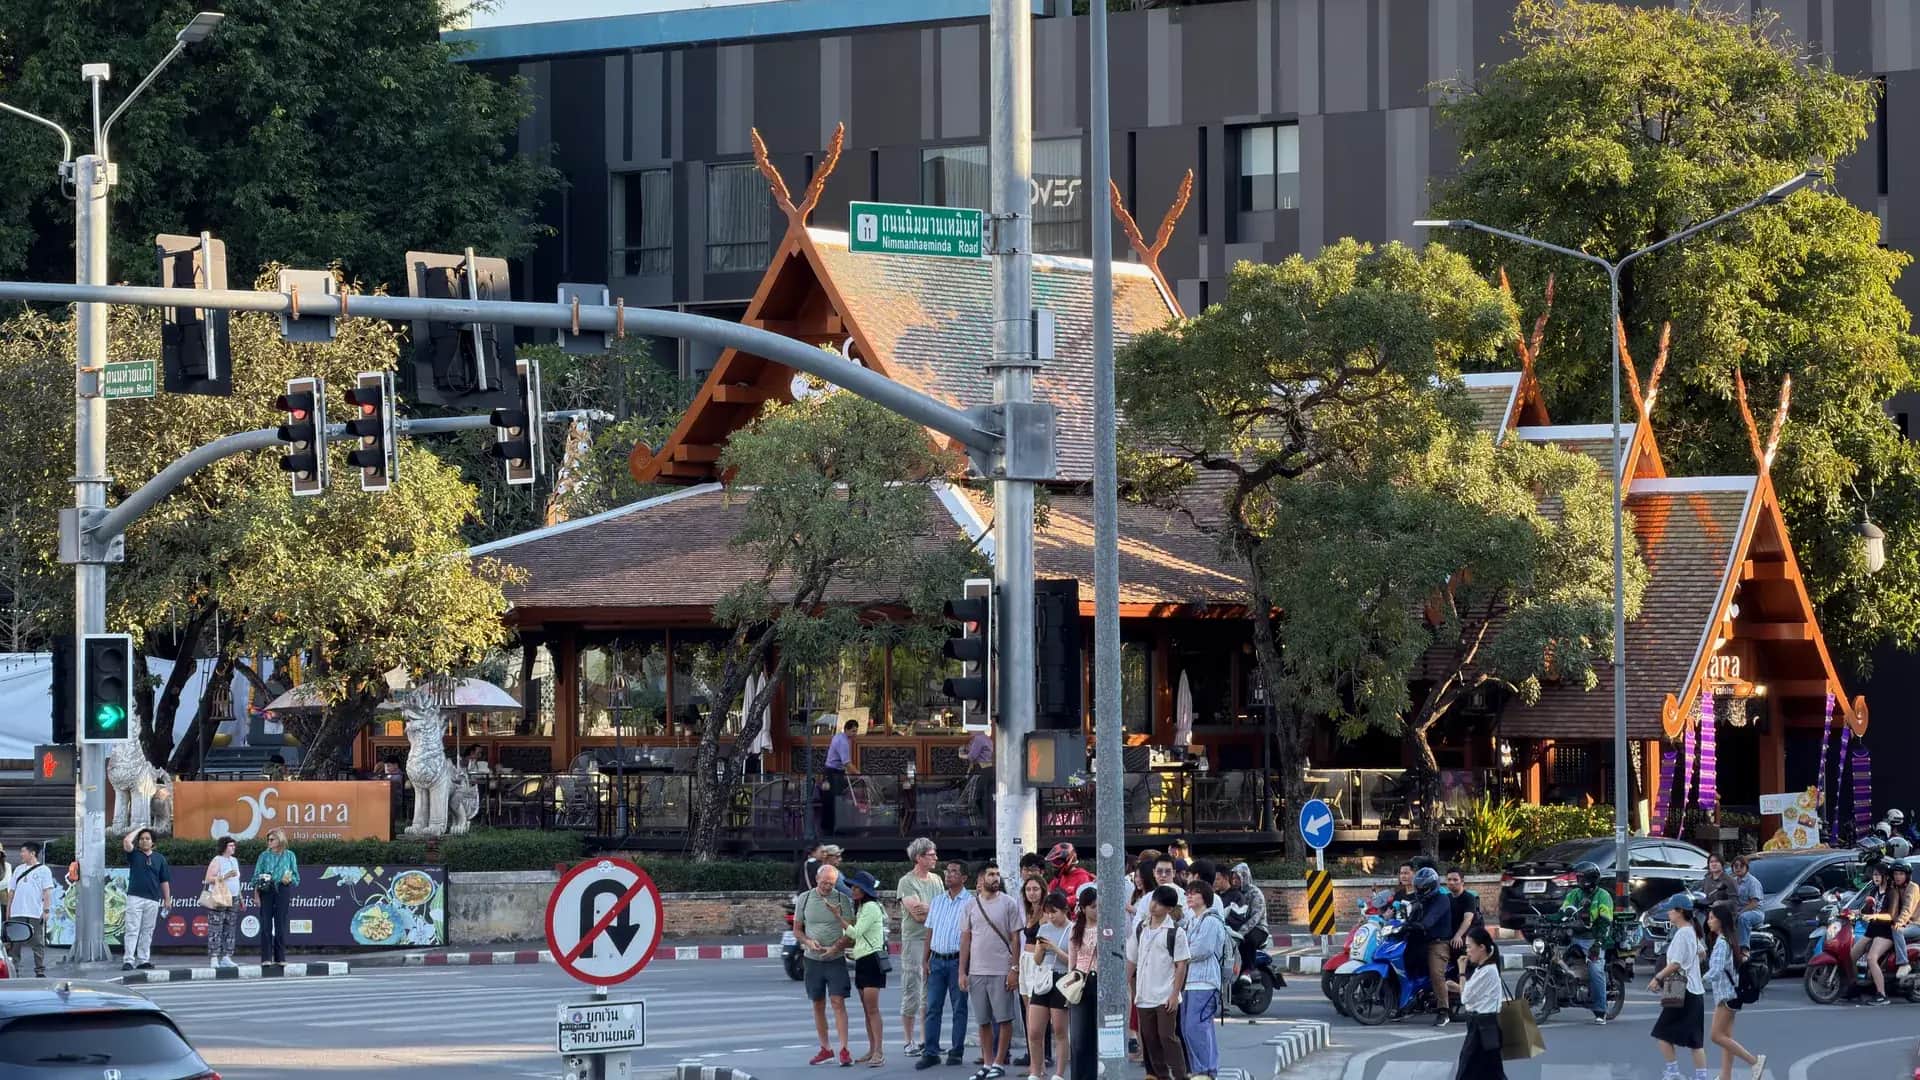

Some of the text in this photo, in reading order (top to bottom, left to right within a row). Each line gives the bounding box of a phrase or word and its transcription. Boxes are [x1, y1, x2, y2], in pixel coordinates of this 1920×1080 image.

[882, 208, 980, 238] ถนนนิมมานเหมินท์
[882, 235, 979, 254] Nimmanhaeminda Road
[136, 384, 152, 393] Road
[286, 803, 349, 824] nara
[587, 1008, 618, 1022] ยกเว้น
[571, 1024, 635, 1043] จกรยานยนต์
